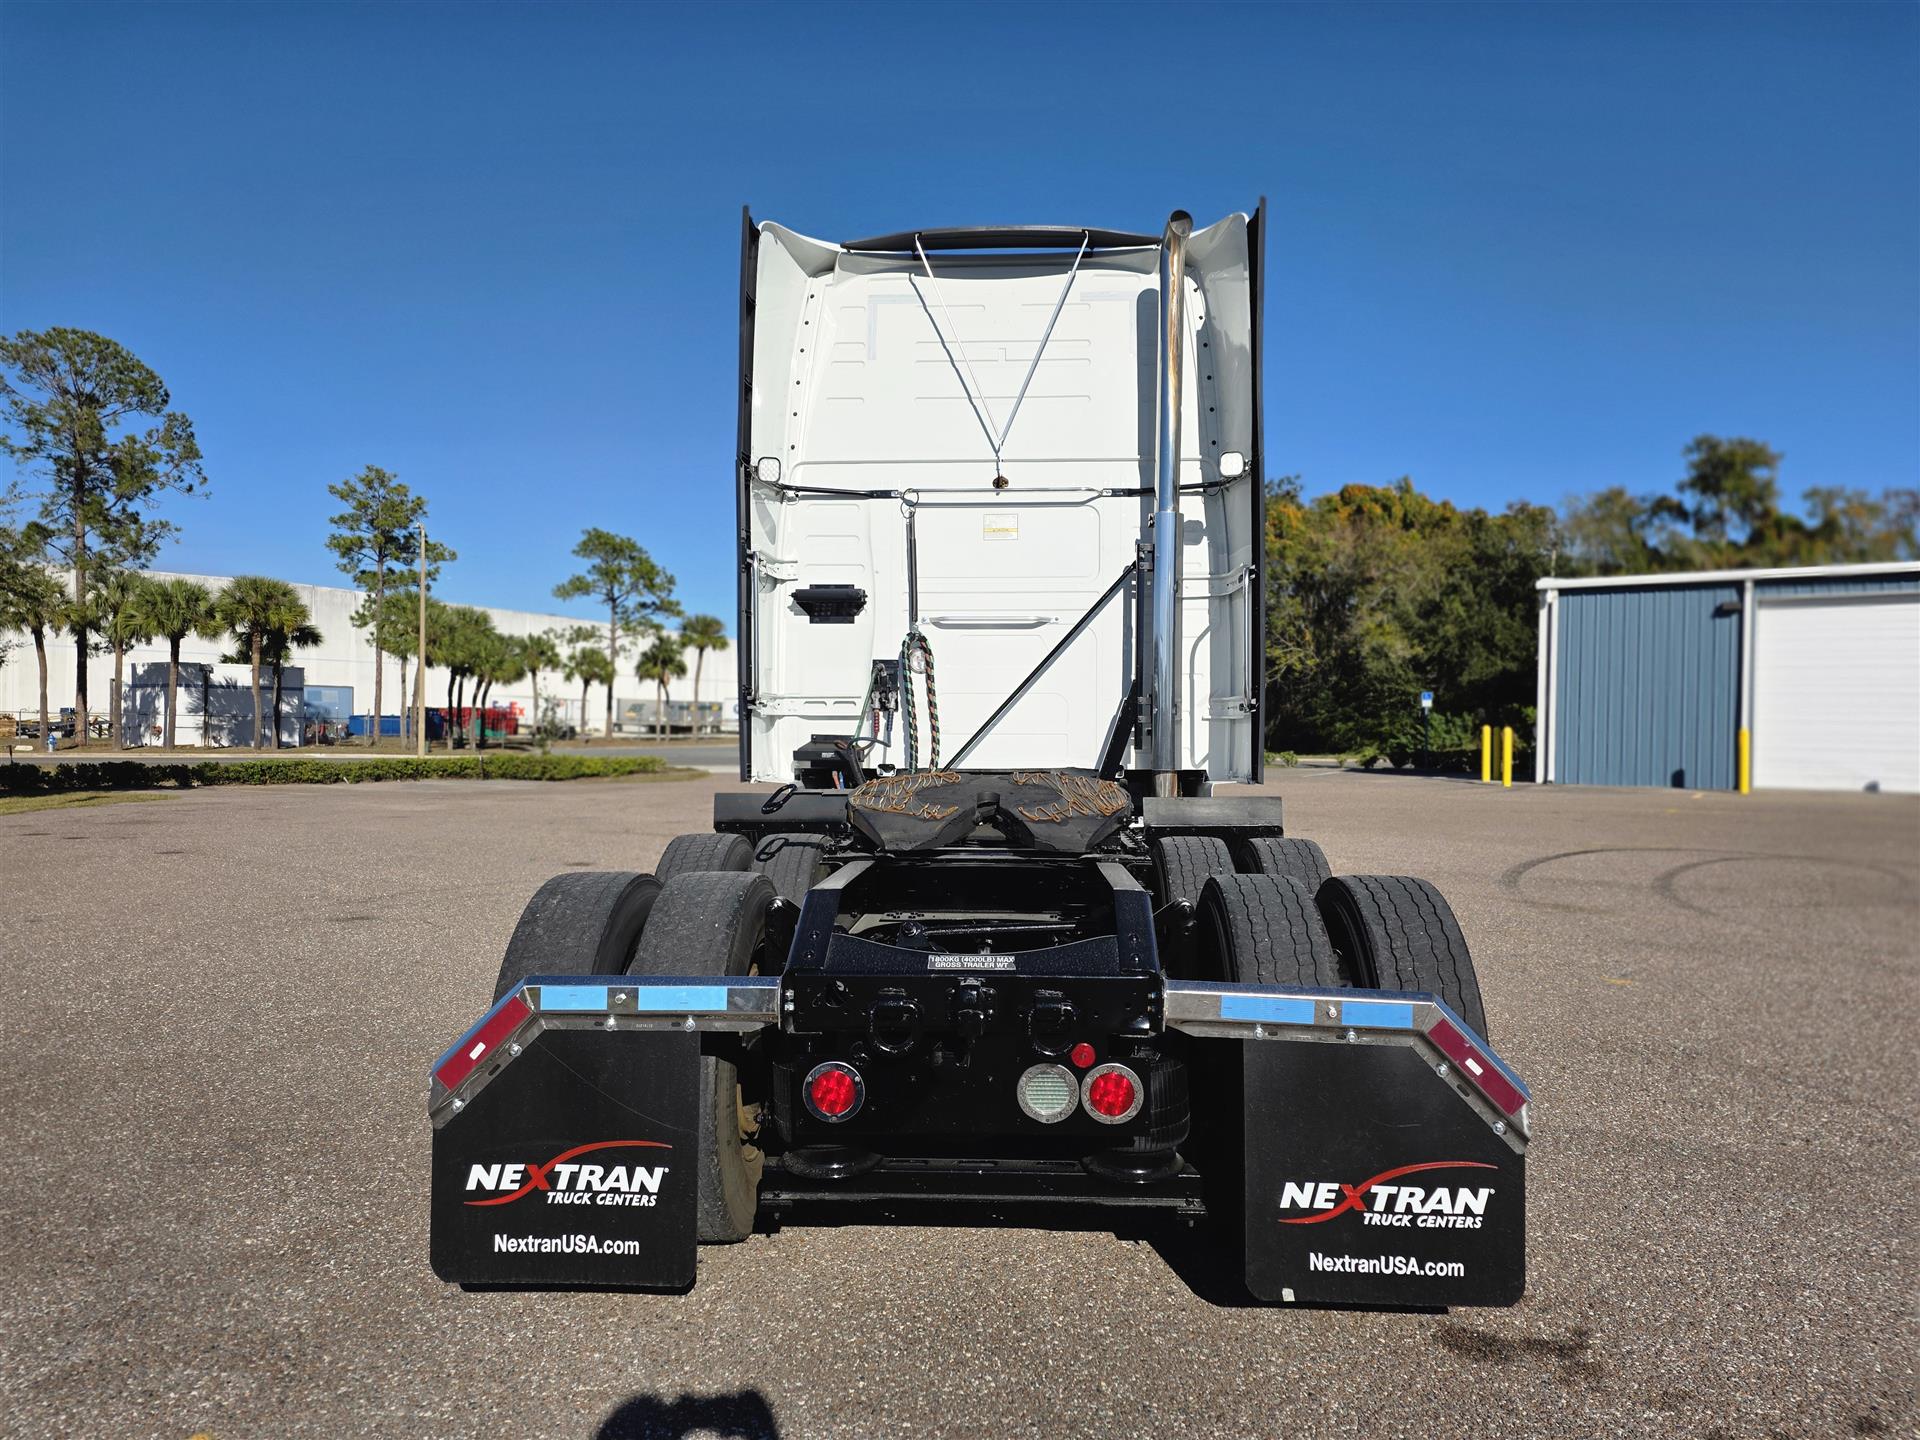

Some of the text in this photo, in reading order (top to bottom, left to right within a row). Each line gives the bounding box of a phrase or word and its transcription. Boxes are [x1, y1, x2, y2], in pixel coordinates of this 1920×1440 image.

[961, 955, 995, 963] (4000LB)
[997, 955, 1015, 963] MAX
[465, 1163, 667, 1193] NEXTRAN
[547, 1191, 657, 1207] TRUCK CENTERS
[1279, 1181, 1494, 1215] NEXTRAN
[1363, 1212, 1483, 1229] TRUCK CENTERS
[494, 1234, 640, 1255] NextranUSA.com
[1309, 1252, 1465, 1277] NextranUSA.com
